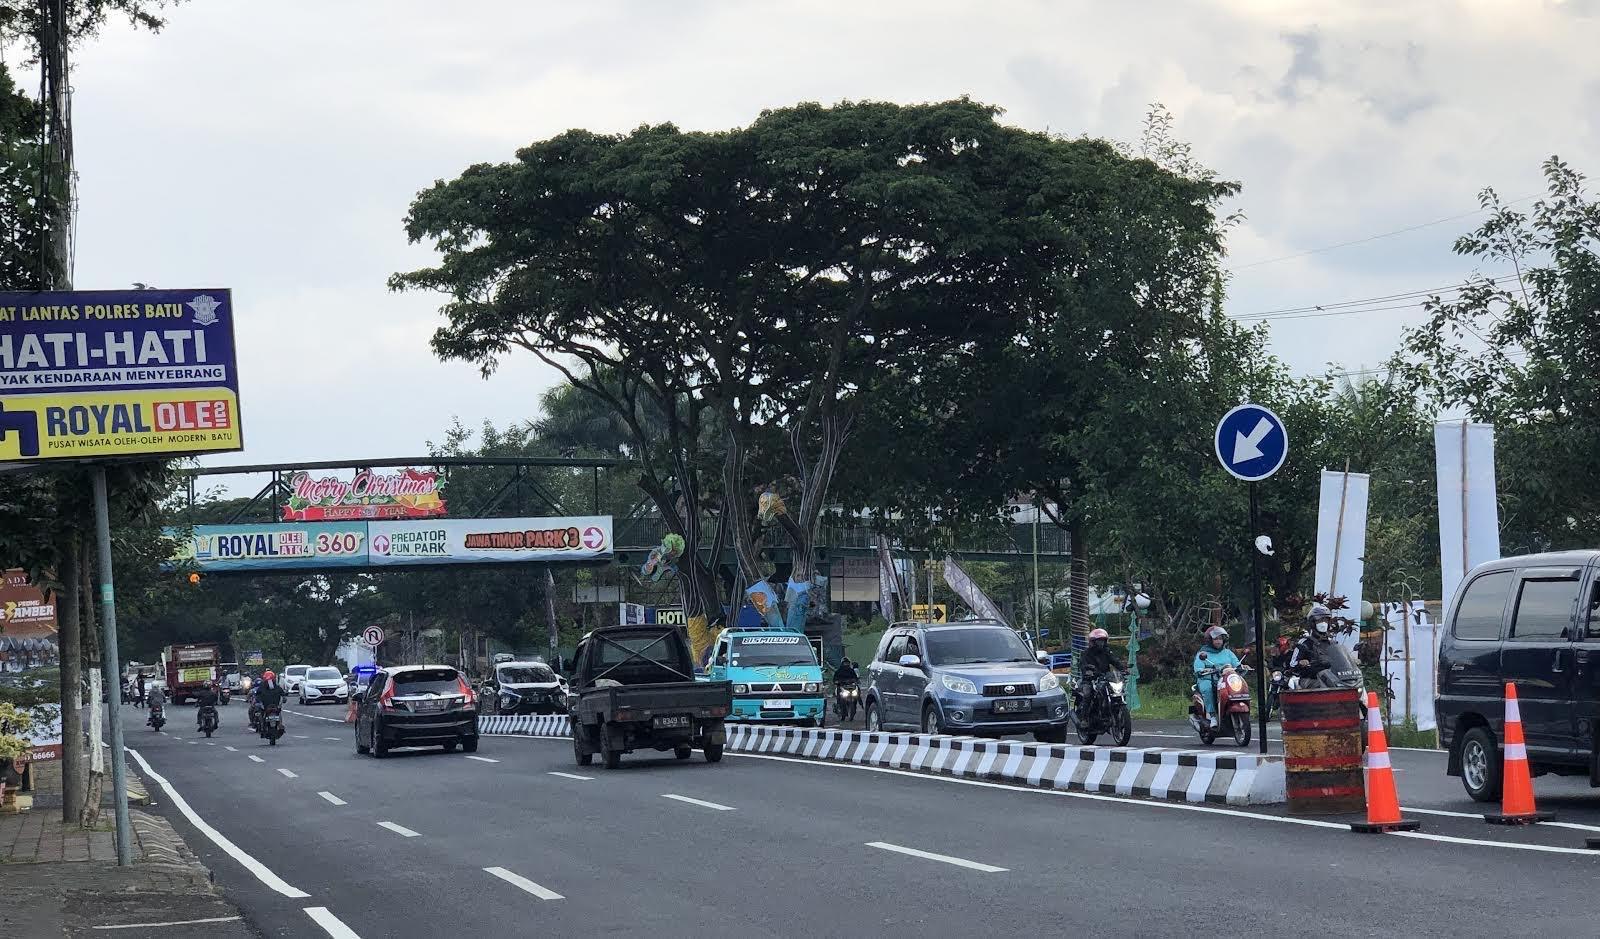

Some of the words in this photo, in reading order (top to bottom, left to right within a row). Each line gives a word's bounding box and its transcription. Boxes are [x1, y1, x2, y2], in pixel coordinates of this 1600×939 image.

[22, 305, 80, 321] LANTAS
[85, 304, 140, 320] POLRES
[145, 303, 183, 318] BATU
[0, 374, 29, 385] YAK
[33, 371, 122, 384] KENDARAAN
[126, 368, 222, 382] MENYEBRANG
[46, 403, 151, 437] ROYAL
[48, 440, 76, 449] PUSAT
[78, 438, 112, 448] WISATA
[114, 436, 163, 446] OLEH-OLEH
[168, 434, 207, 443] MODERN
[212, 432, 233, 441] BATU
[291, 471, 350, 505] Merry
[351, 467, 435, 497] Christmas
[218, 533, 278, 557] ROYAL
[391, 530, 446, 543] PREDATOR
[465, 533, 493, 549] JAWA
[491, 532, 525, 549] TIMUR
[525, 529, 567, 548] PARK
[567, 526, 580, 548] 3
[391, 543, 410, 554] FUN
[414, 542, 446, 554] PARK
[14, 605, 54, 618] AMBER
[742, 637, 800, 645] BISMILLAH
